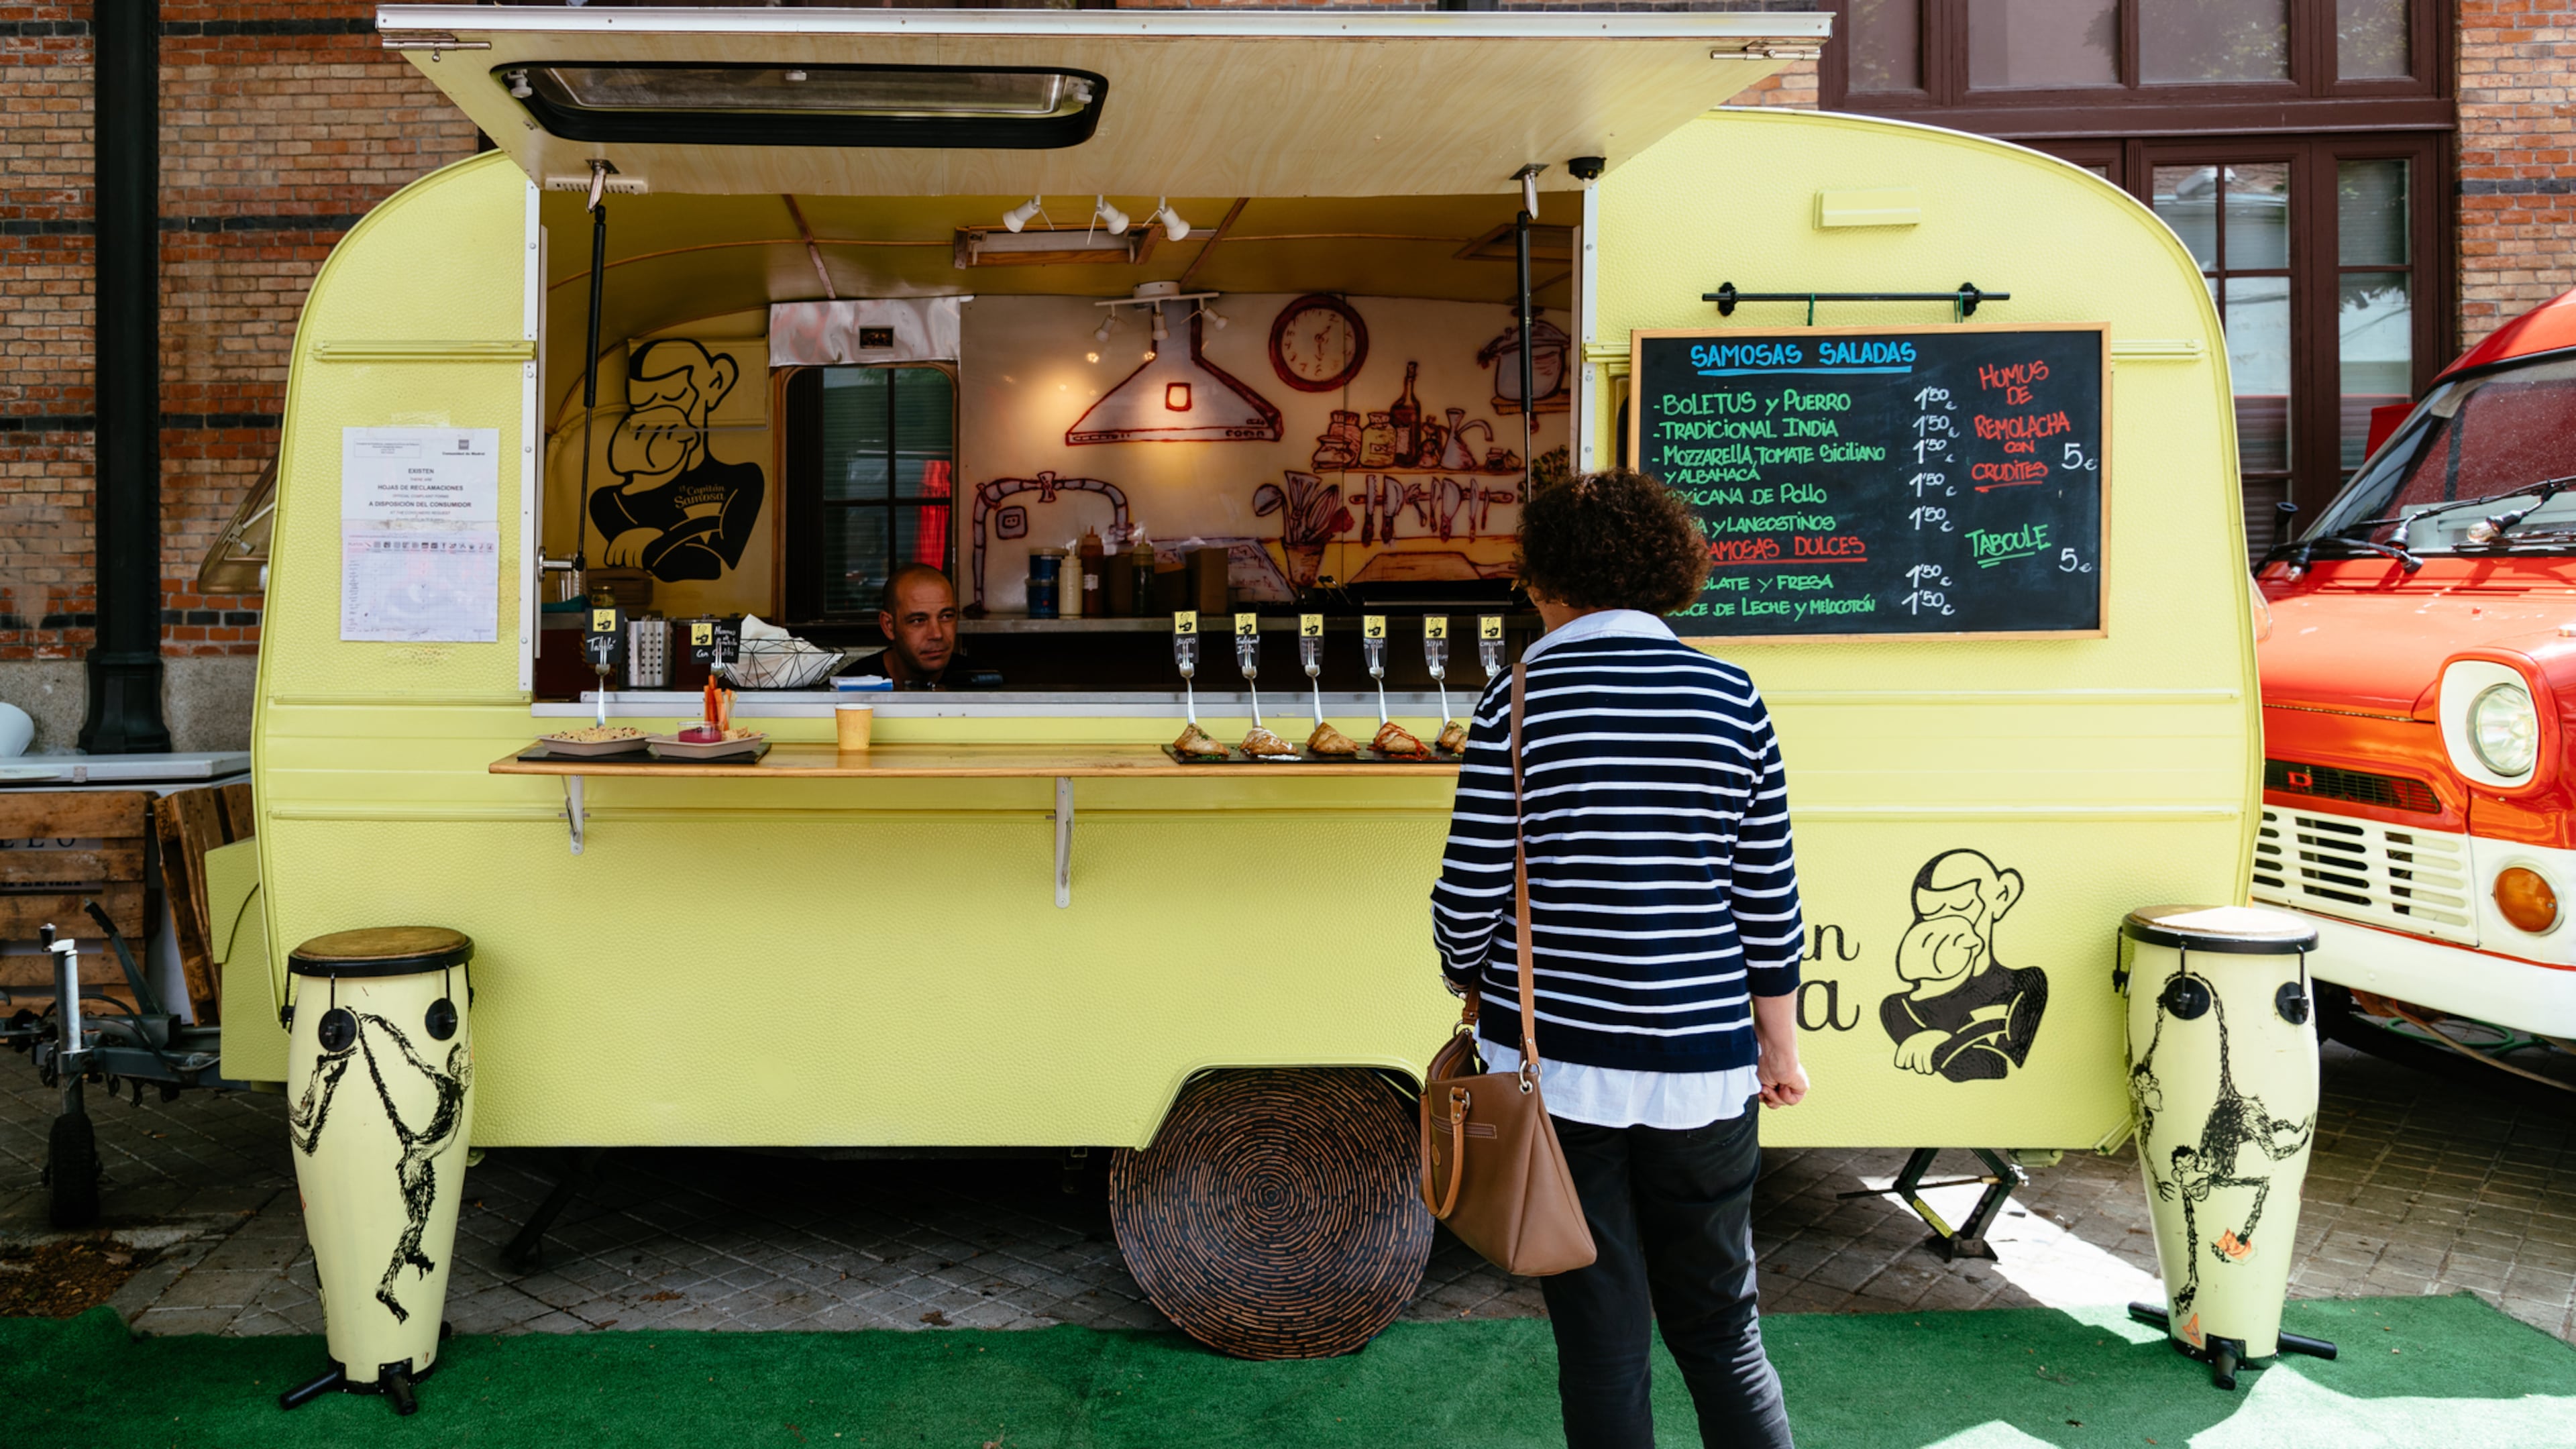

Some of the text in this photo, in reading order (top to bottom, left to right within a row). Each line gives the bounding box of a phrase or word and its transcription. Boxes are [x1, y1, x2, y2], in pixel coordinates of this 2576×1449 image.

[1690, 341, 1917, 368] SAMOSAS SALADAS
[1978, 360, 2049, 390] HUMUS
[1783, 388, 1851, 412] PUERRO
[2005, 383, 2033, 405] DE
[1781, 417, 1839, 437] INDIA
[1974, 411, 2071, 439] REMOLACHA
[1754, 446, 1815, 466] TOMATE
[2004, 439, 2035, 453] CON
[1971, 460, 2048, 481] CRUDITES
[674, 493, 726, 509] Samosa
[1750, 488, 1774, 506] DE
[1727, 511, 1837, 533] LANGOSTINOS
[1709, 536, 1866, 560] AMOSAS DULCES
[1964, 523, 2052, 557] TABOULE
[1776, 574, 1834, 591] FRESA
[1712, 602, 1735, 617] DE
[1741, 596, 1791, 616] LECHE
